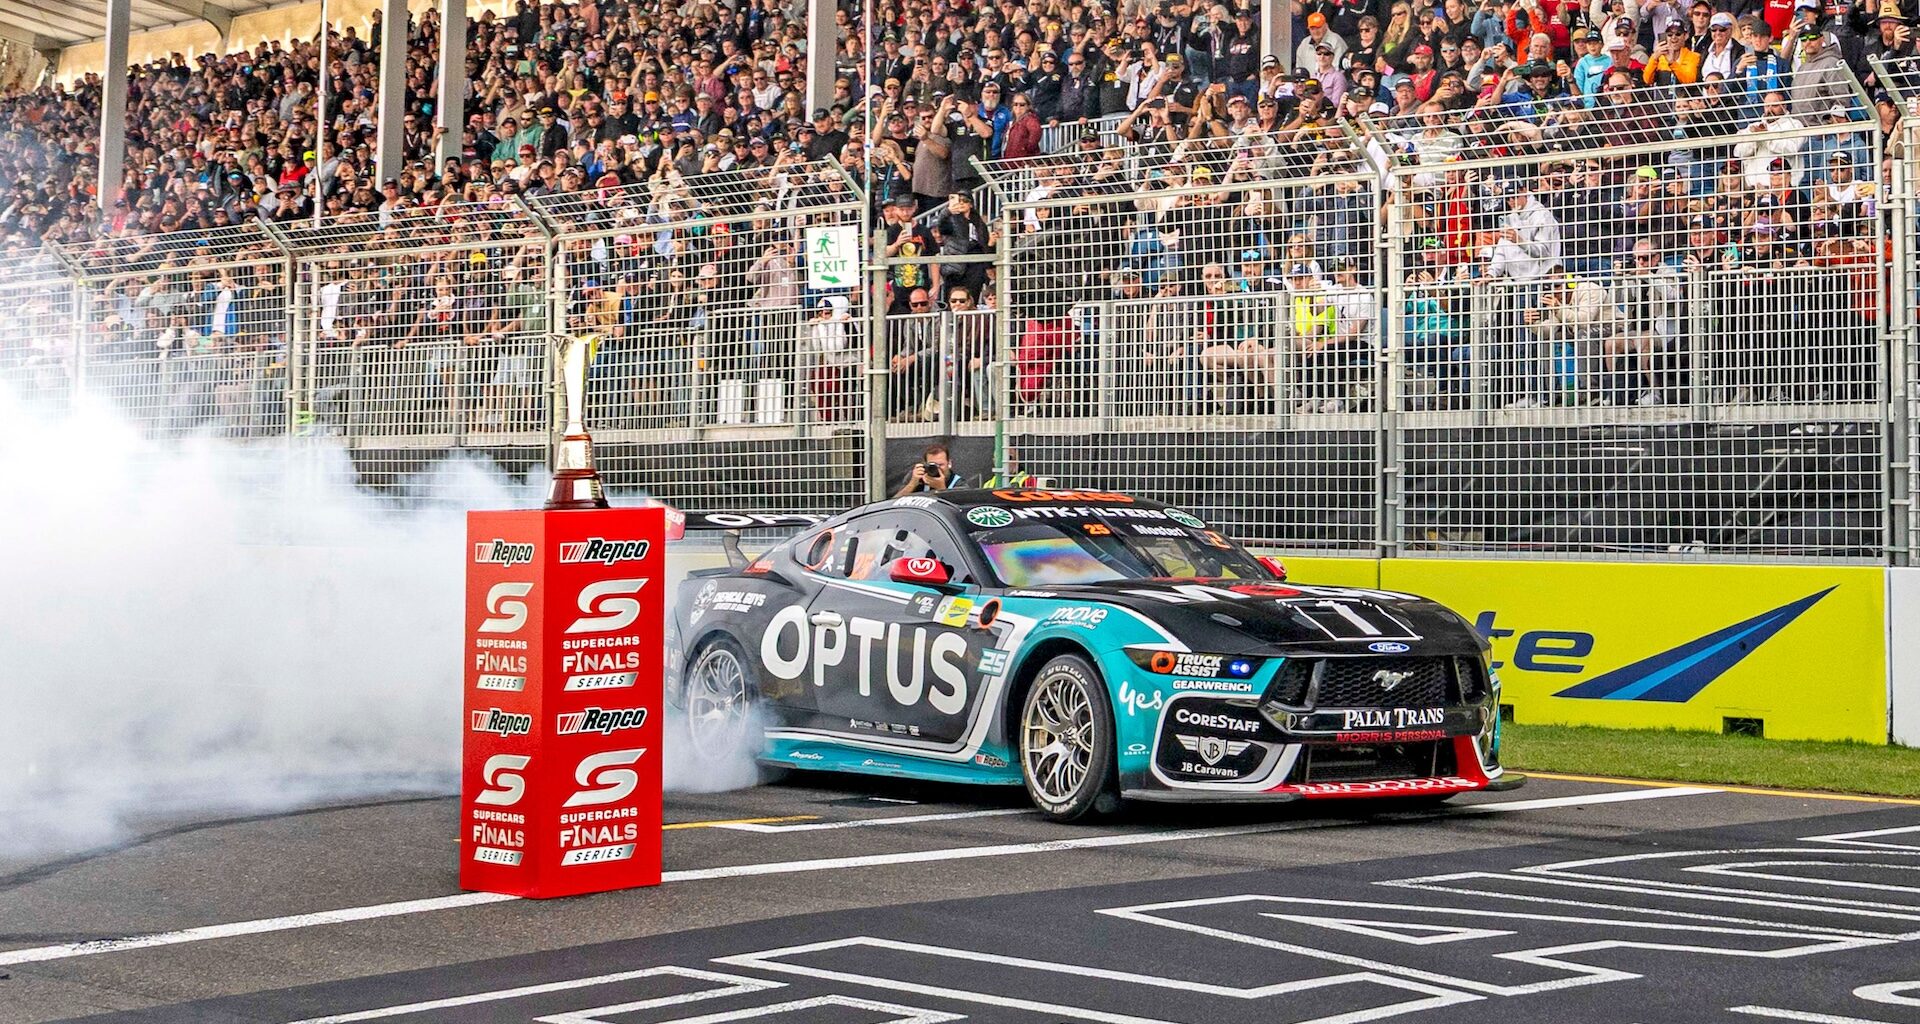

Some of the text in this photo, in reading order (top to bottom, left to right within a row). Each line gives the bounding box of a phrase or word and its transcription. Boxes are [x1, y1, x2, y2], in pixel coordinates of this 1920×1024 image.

[813, 260, 848, 273] EXIT
[1011, 507, 1168, 520] NTK FILTERS
[1083, 524, 1110, 535] 25
[1132, 524, 1189, 538] Mostert
[492, 541, 533, 565] Repco
[584, 539, 649, 564] Repco
[1048, 607, 1108, 624] move
[476, 639, 528, 650] SUPERCARS
[563, 636, 640, 650] SUPERCARS
[1374, 642, 1403, 654] Ford
[476, 651, 527, 673] FINALS
[562, 651, 640, 673] FINALS
[760, 604, 967, 715] OPTUS
[978, 651, 1008, 675] 25
[1176, 653, 1223, 667] TRUCK
[1172, 664, 1220, 678] ASSIST
[485, 677, 518, 689] SERIES
[577, 675, 626, 689] SERIES
[1172, 680, 1252, 692] GEARWRENCH
[488, 710, 530, 735] Repco
[582, 708, 646, 733] Repco
[1342, 707, 1445, 730] PALM TRANS
[1336, 730, 1447, 743] MORRIS PERSONAL
[1205, 743, 1219, 760] JB
[1181, 762, 1239, 778] JB Caravans
[473, 809, 525, 824] SUPERCARS
[560, 807, 638, 824] SUPERCARS
[473, 822, 525, 847] FINALS
[560, 823, 637, 848] FINALS
[482, 849, 515, 863] SERIES
[574, 847, 623, 862] SERIES
